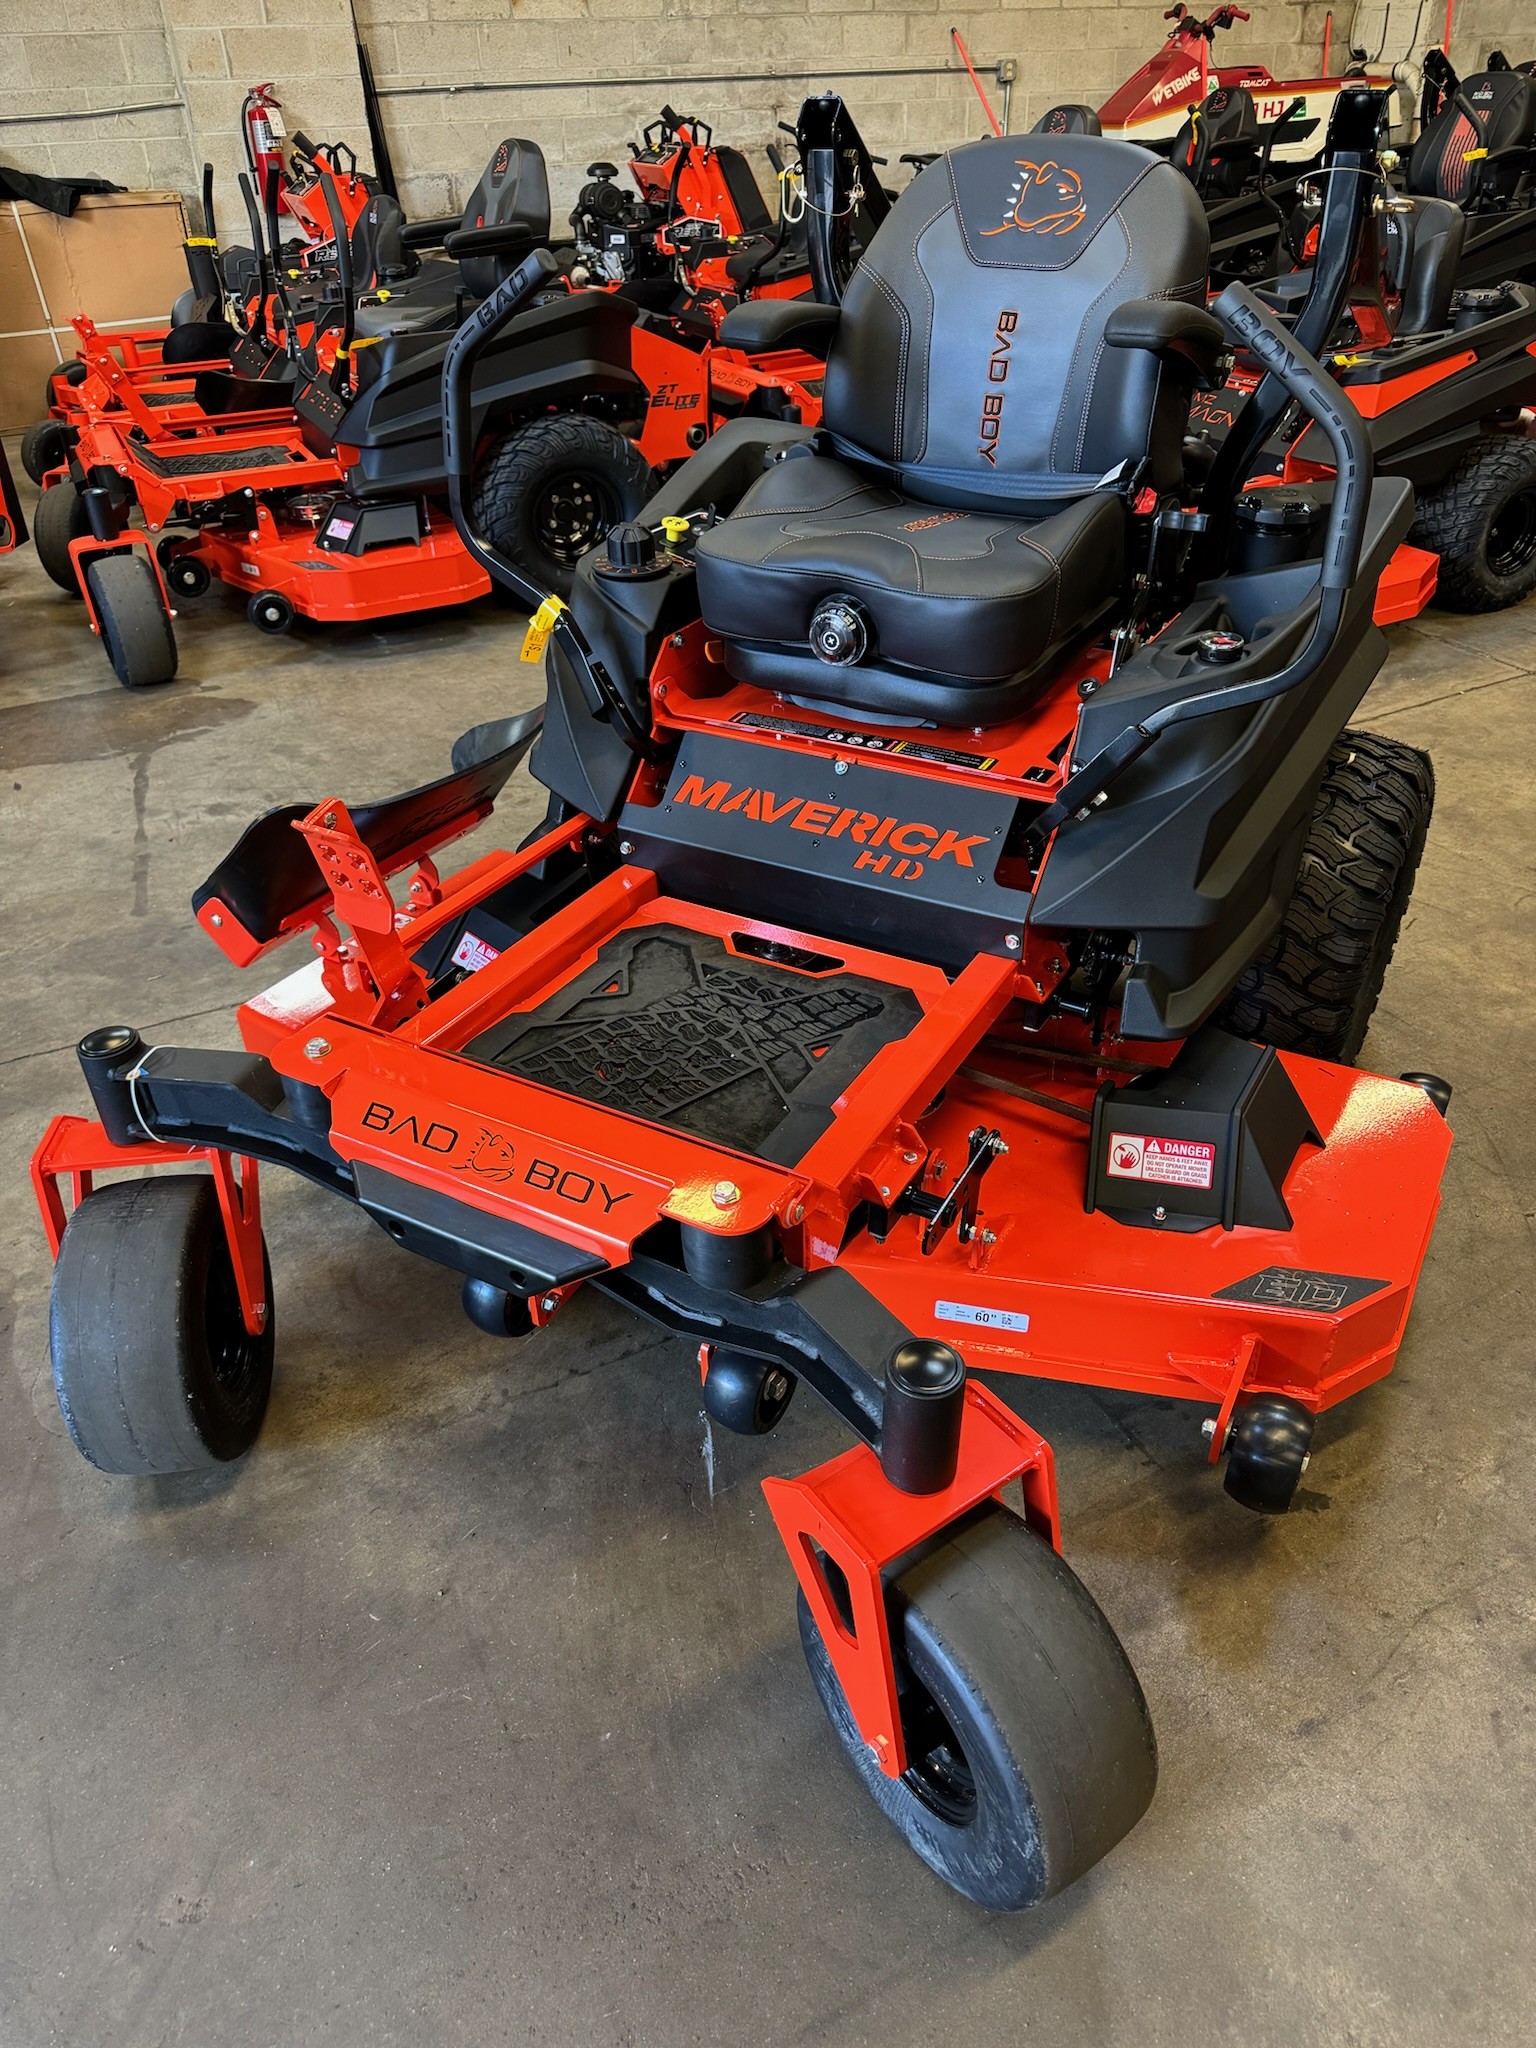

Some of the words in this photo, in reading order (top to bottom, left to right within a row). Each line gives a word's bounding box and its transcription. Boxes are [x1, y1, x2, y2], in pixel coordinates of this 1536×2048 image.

[1152, 66, 1202, 107] WETBIKE
[1239, 78, 1272, 88] TOMCAT
[476, 267, 529, 330] BAD
[988, 308, 1020, 385] BAD
[1227, 303, 1313, 380] BOY
[656, 383, 679, 395] ZT
[650, 393, 701, 411] ELITE
[977, 393, 1005, 469] BOY
[672, 774, 991, 869] MAVERICK
[852, 850, 925, 881] HD
[360, 1100, 459, 1154] BAD
[523, 1157, 635, 1215] BOY
[1164, 1141, 1210, 1158] DANGER
[1159, 1155, 1176, 1163] HANDS
[1165, 1161, 1187, 1170] OPERATE
[1148, 1172, 1170, 1180] CATCHER
[1190, 1171, 1208, 1179] GRASS
[975, 1311, 997, 1323] 60"
